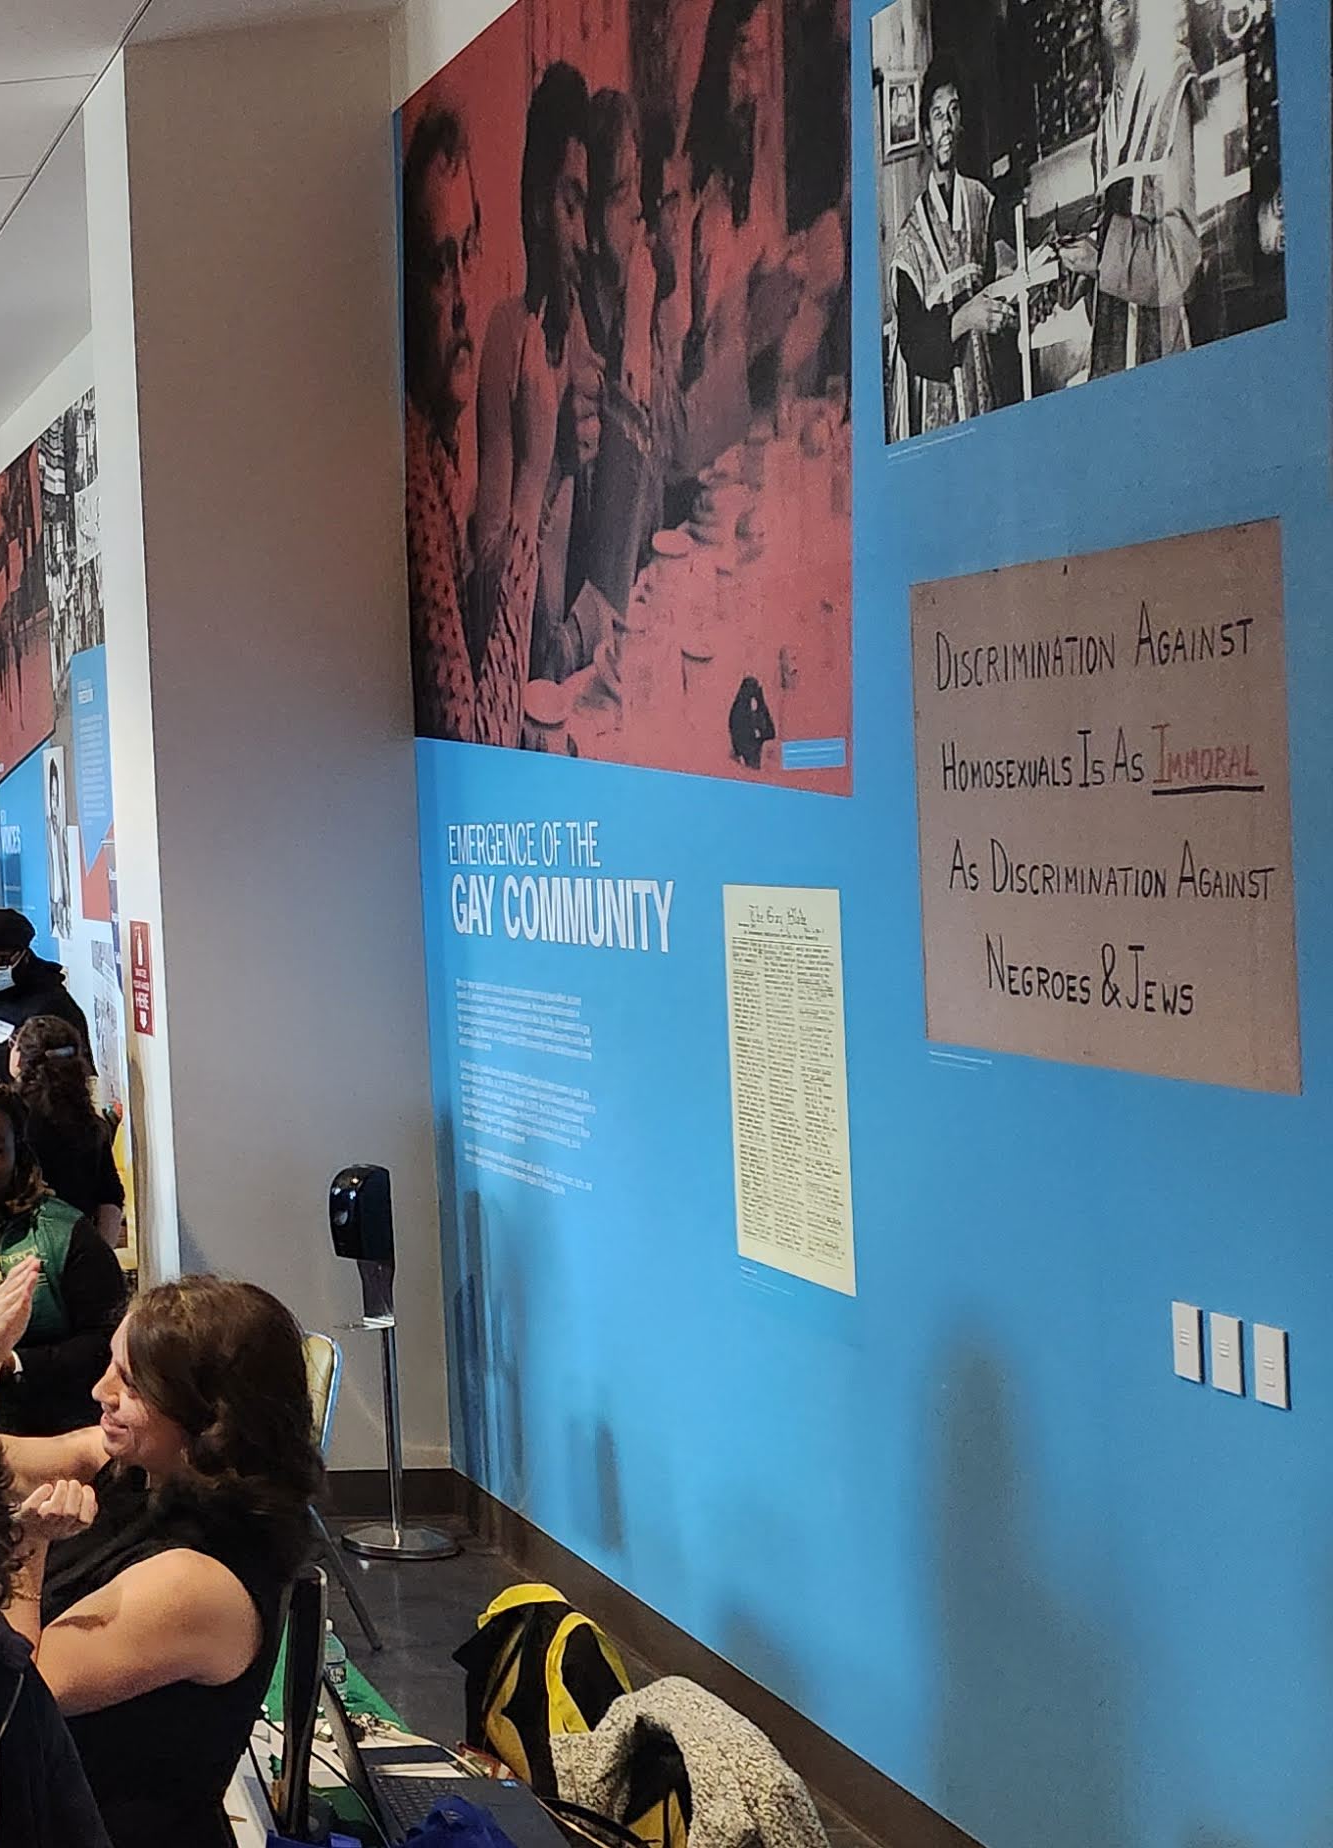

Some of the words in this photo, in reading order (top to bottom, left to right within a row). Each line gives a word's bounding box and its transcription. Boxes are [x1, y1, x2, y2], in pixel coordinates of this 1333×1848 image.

[447, 821, 537, 867] EMERGENCE
[540, 821, 562, 867] OF
[565, 820, 601, 868] THE
[451, 874, 495, 936] GAY
[502, 874, 675, 953] COMMUNITY
[1101, 942, 1121, 1009] &
